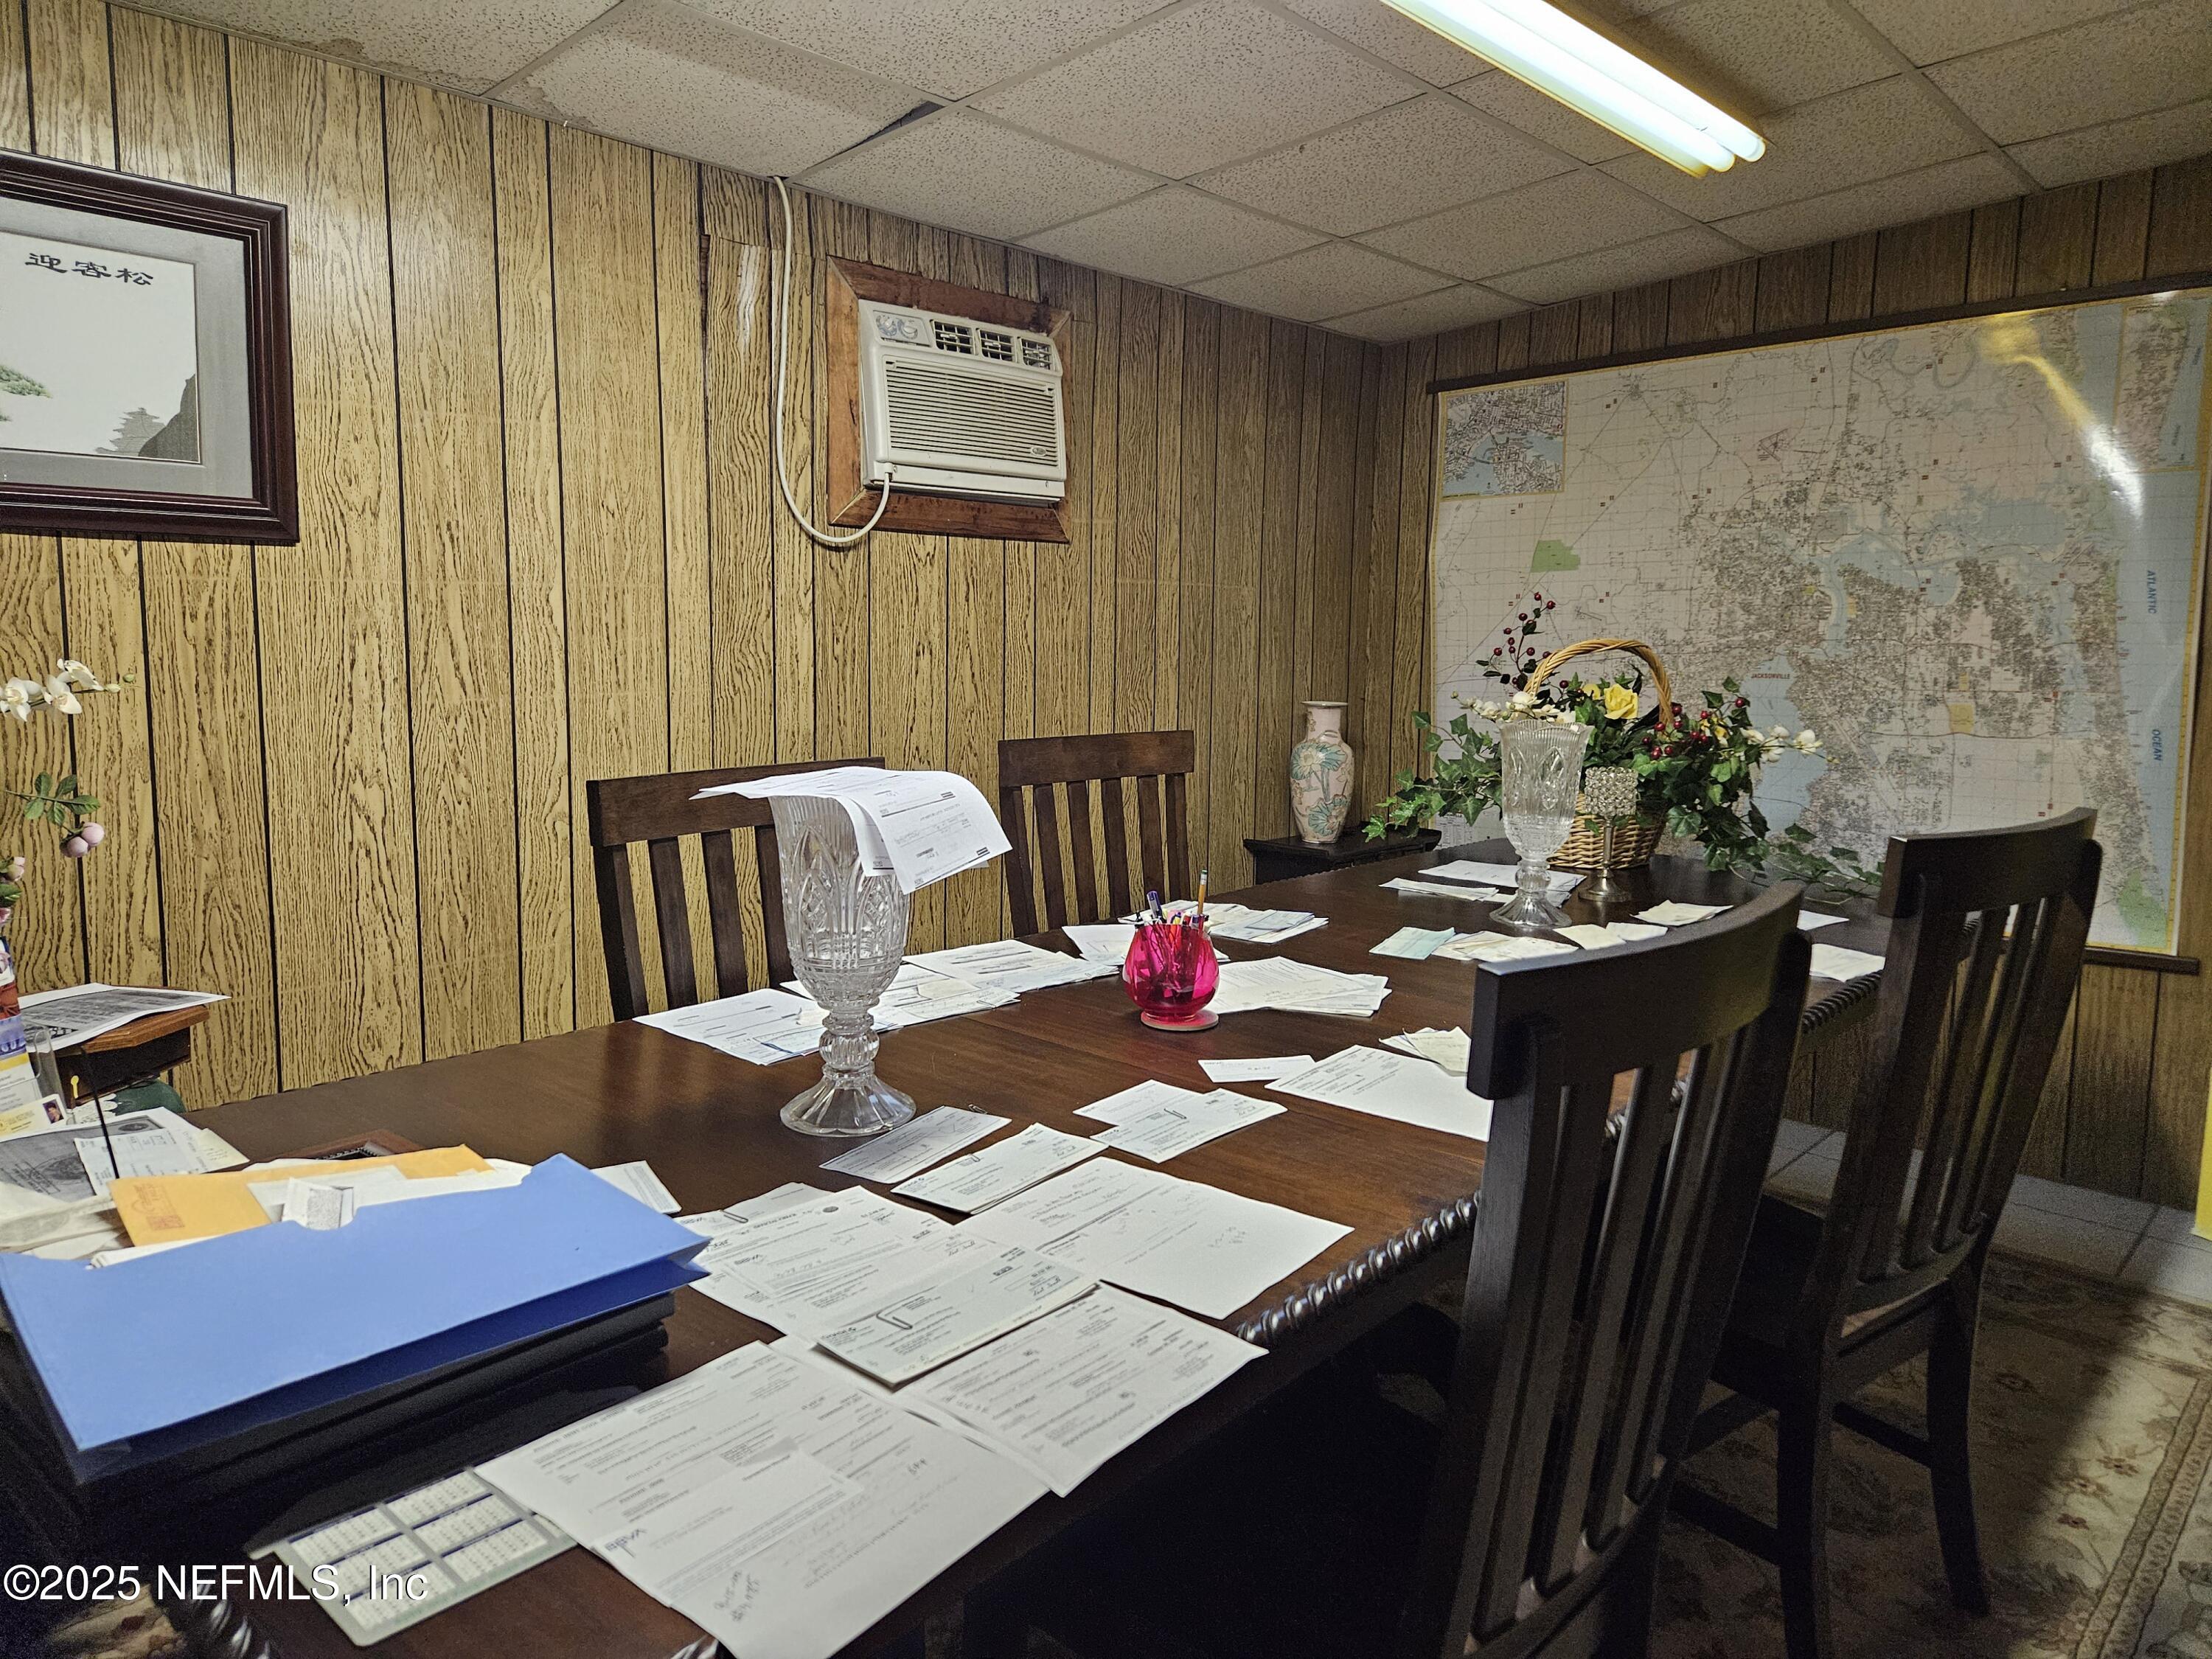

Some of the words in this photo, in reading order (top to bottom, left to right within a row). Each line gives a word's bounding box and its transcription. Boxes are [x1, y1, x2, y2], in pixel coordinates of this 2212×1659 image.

[25, 251, 153, 286] 迎客松
[2146, 569, 2157, 614] ATLANTIC
[2152, 728, 2163, 761] OCEAN
